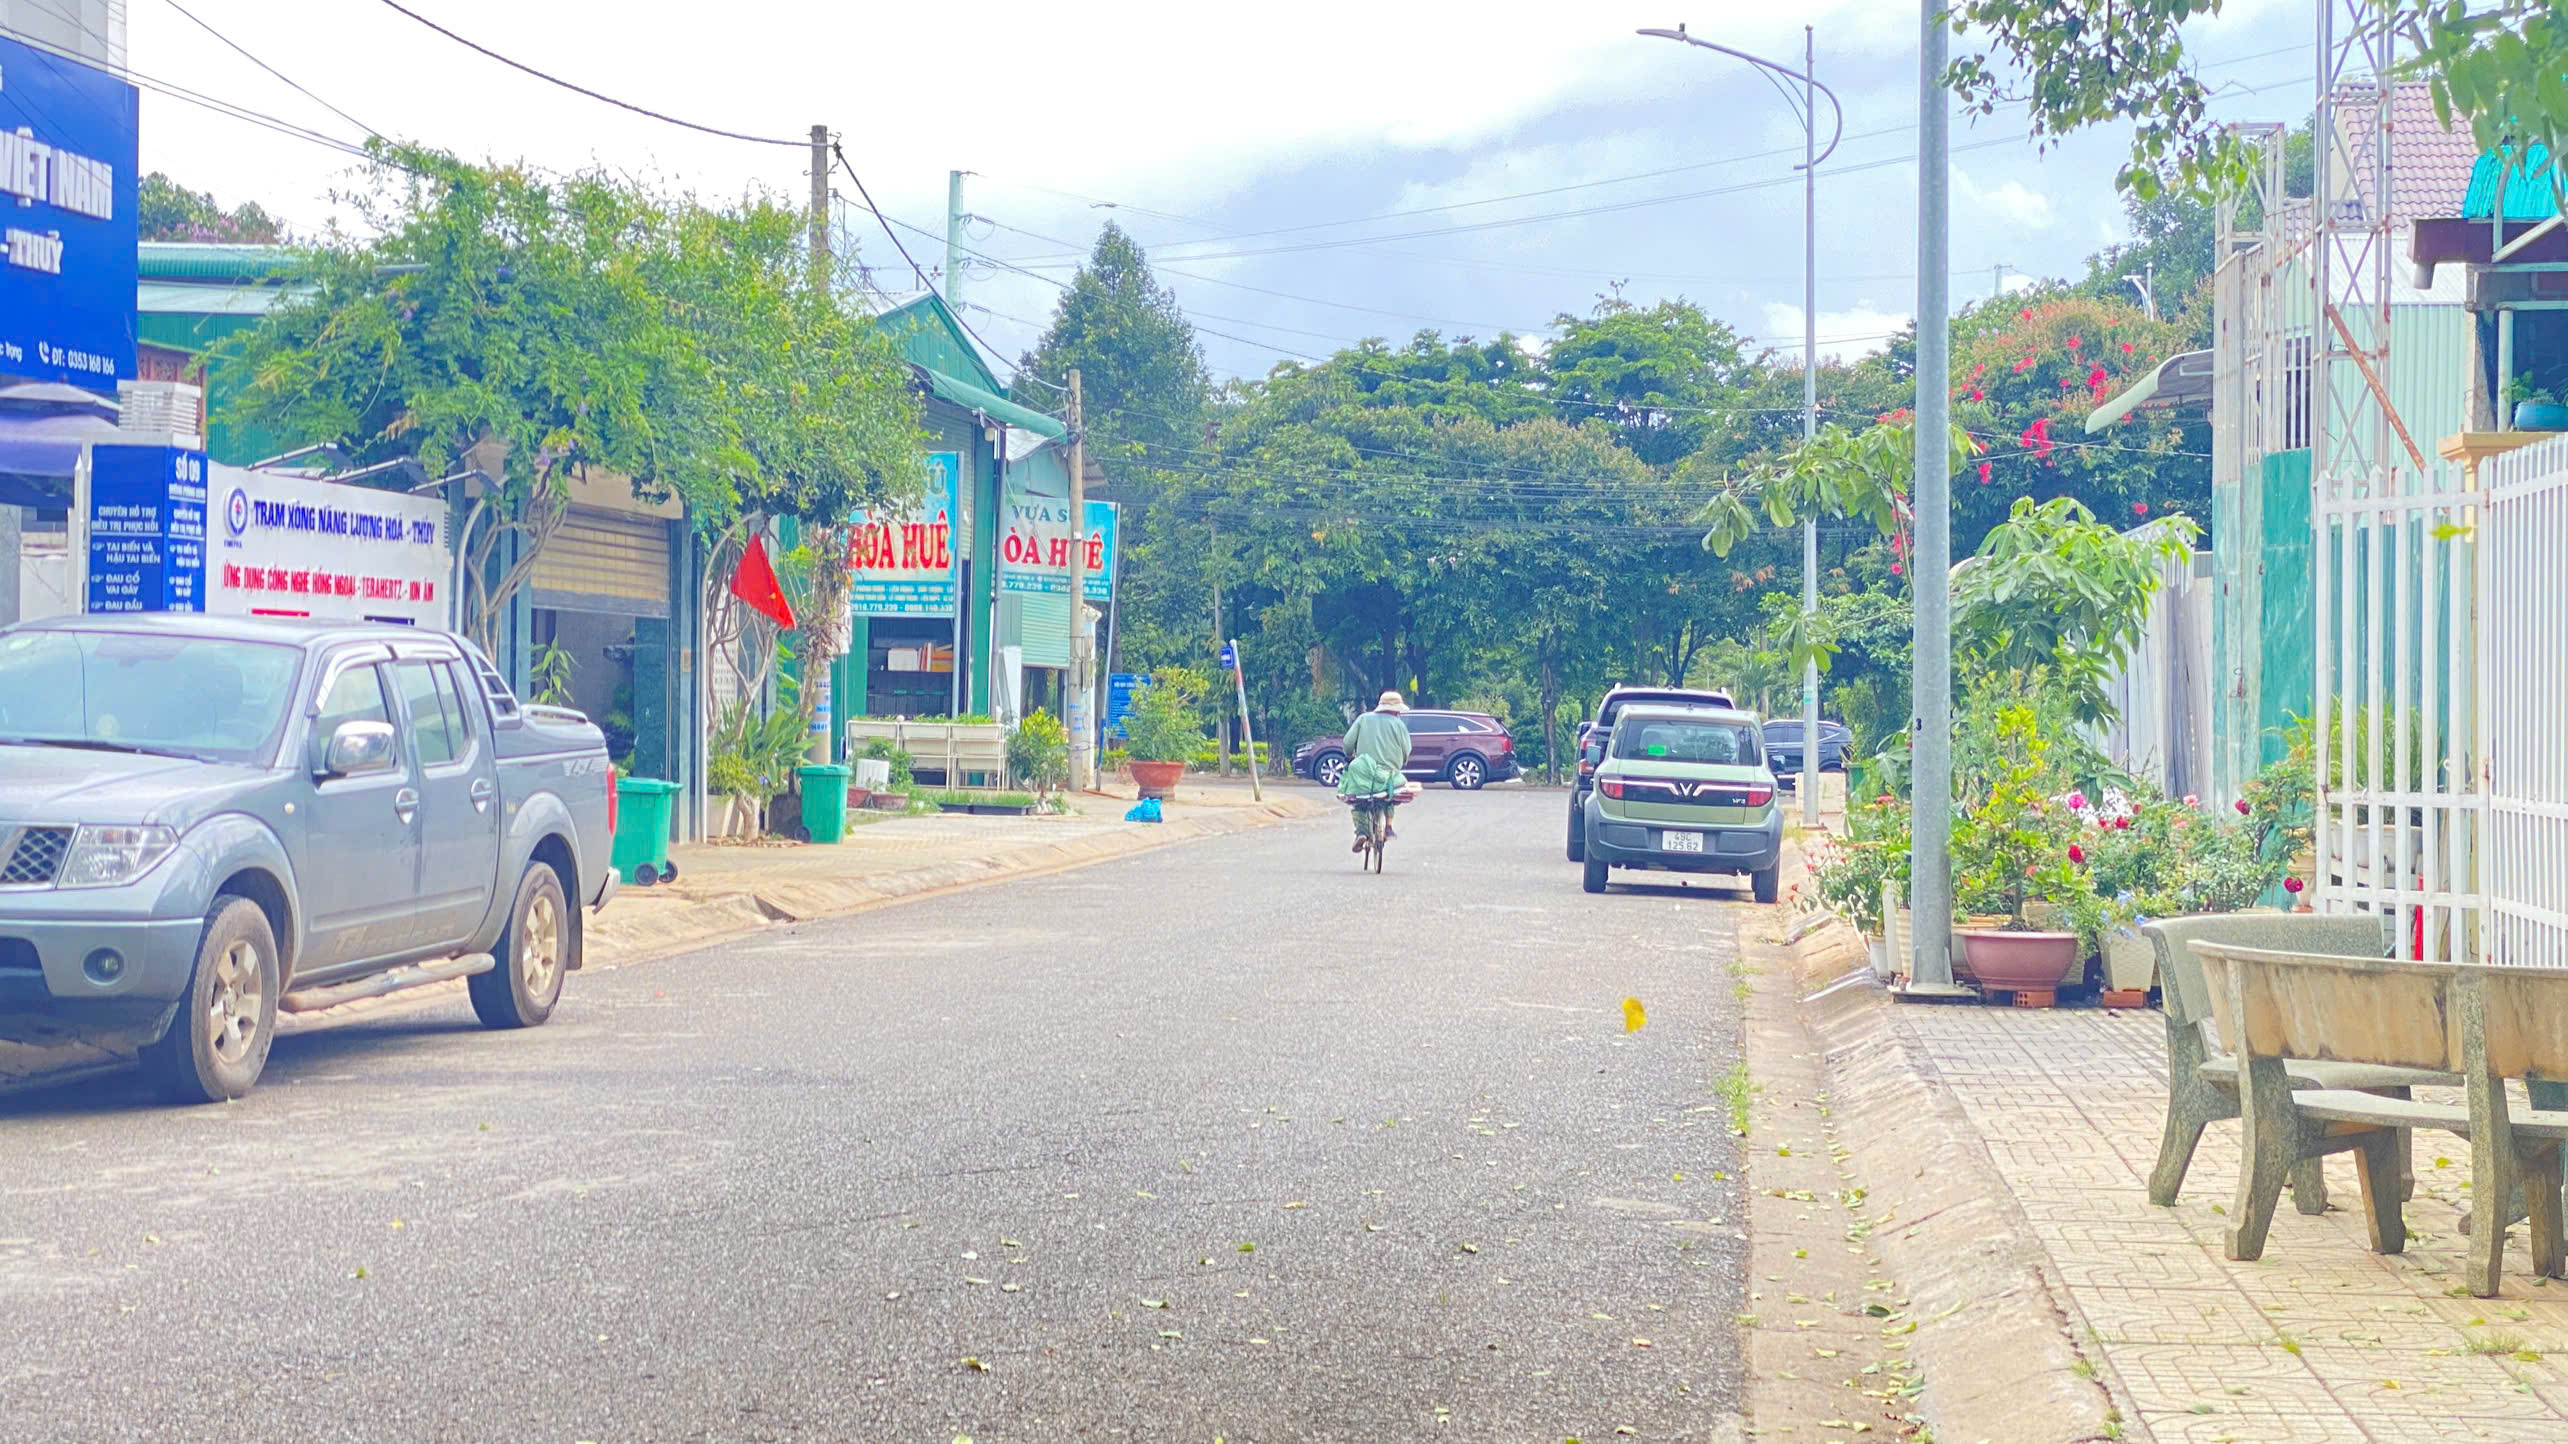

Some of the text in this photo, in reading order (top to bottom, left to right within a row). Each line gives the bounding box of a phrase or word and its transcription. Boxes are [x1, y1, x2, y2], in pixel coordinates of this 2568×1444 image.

[51, 149, 112, 220] NAM
[67, 350, 87, 371] 0353
[102, 356, 114, 376] 166
[189, 459, 200, 483] 09
[254, 499, 285, 531] TRẠM
[288, 501, 315, 531] XÔNG
[318, 504, 347, 535] NĂNG
[350, 512, 382, 541] LƯỢNG
[106, 540, 154, 551] TAI BIẾN VÀ
[902, 509, 950, 569] HUÊ
[1003, 526, 1042, 565] ÒA
[126, 554, 139, 563] TAI
[141, 552, 161, 564] BIẾN
[106, 574, 124, 583] ĐAU
[106, 585, 120, 594] VAI
[244, 566, 264, 593] DỤNG
[335, 574, 355, 599] NGOẠI
[362, 577, 402, 600] TERAHERTZ
[105, 600, 123, 610] ĐAU
